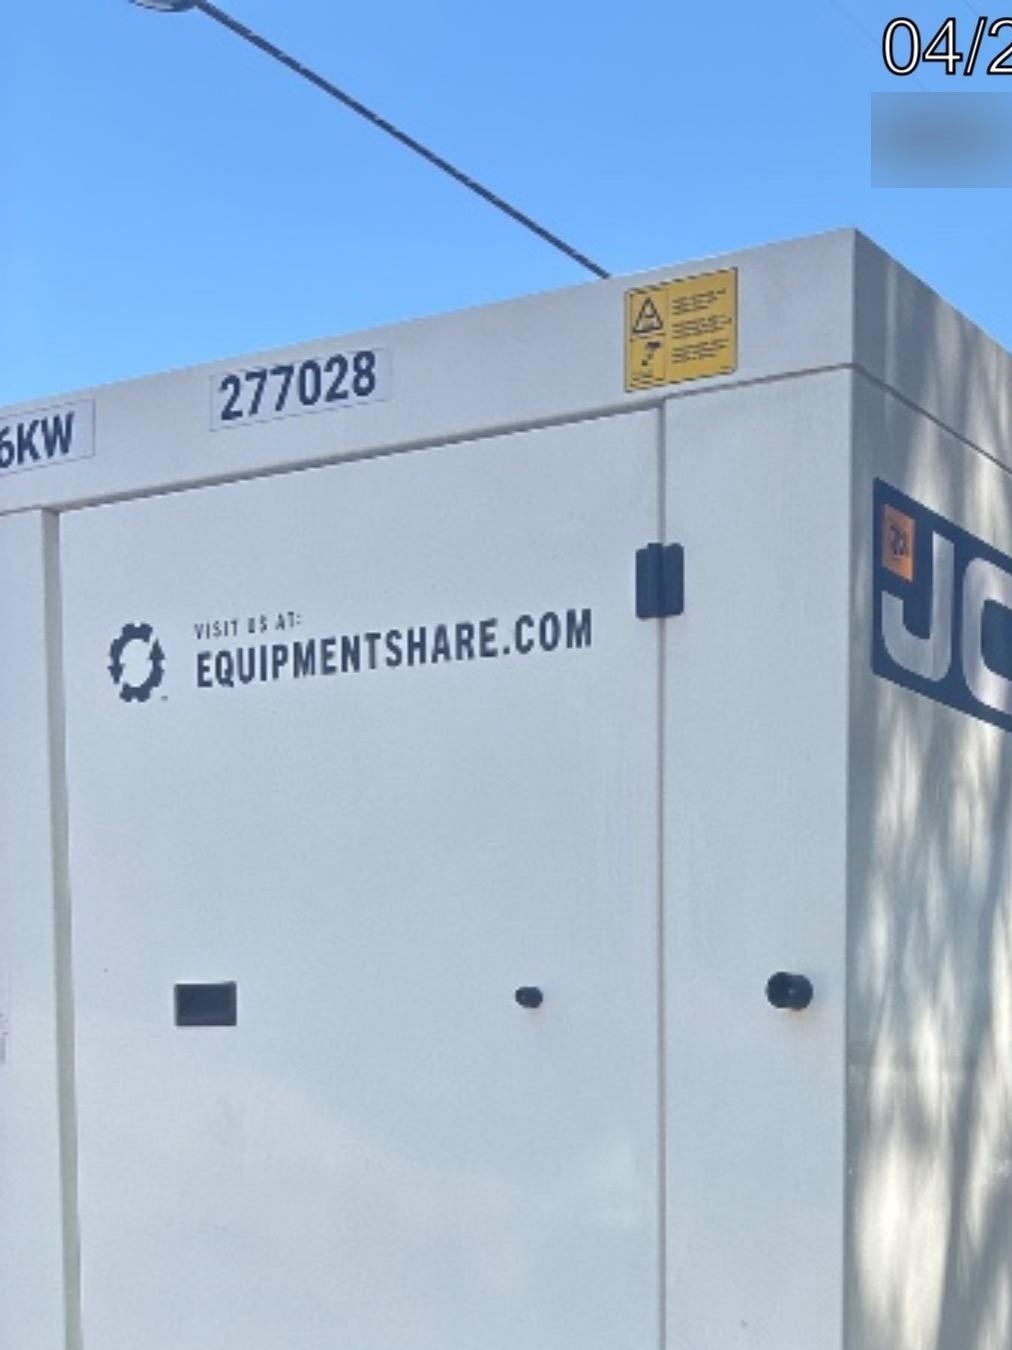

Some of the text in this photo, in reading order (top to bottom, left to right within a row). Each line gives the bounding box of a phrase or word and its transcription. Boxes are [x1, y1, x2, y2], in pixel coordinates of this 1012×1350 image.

[219, 350, 376, 421] 277028
[194, 611, 302, 640] VISIT US AT:
[196, 608, 592, 688] EQUIPMENTSHARE.COM
